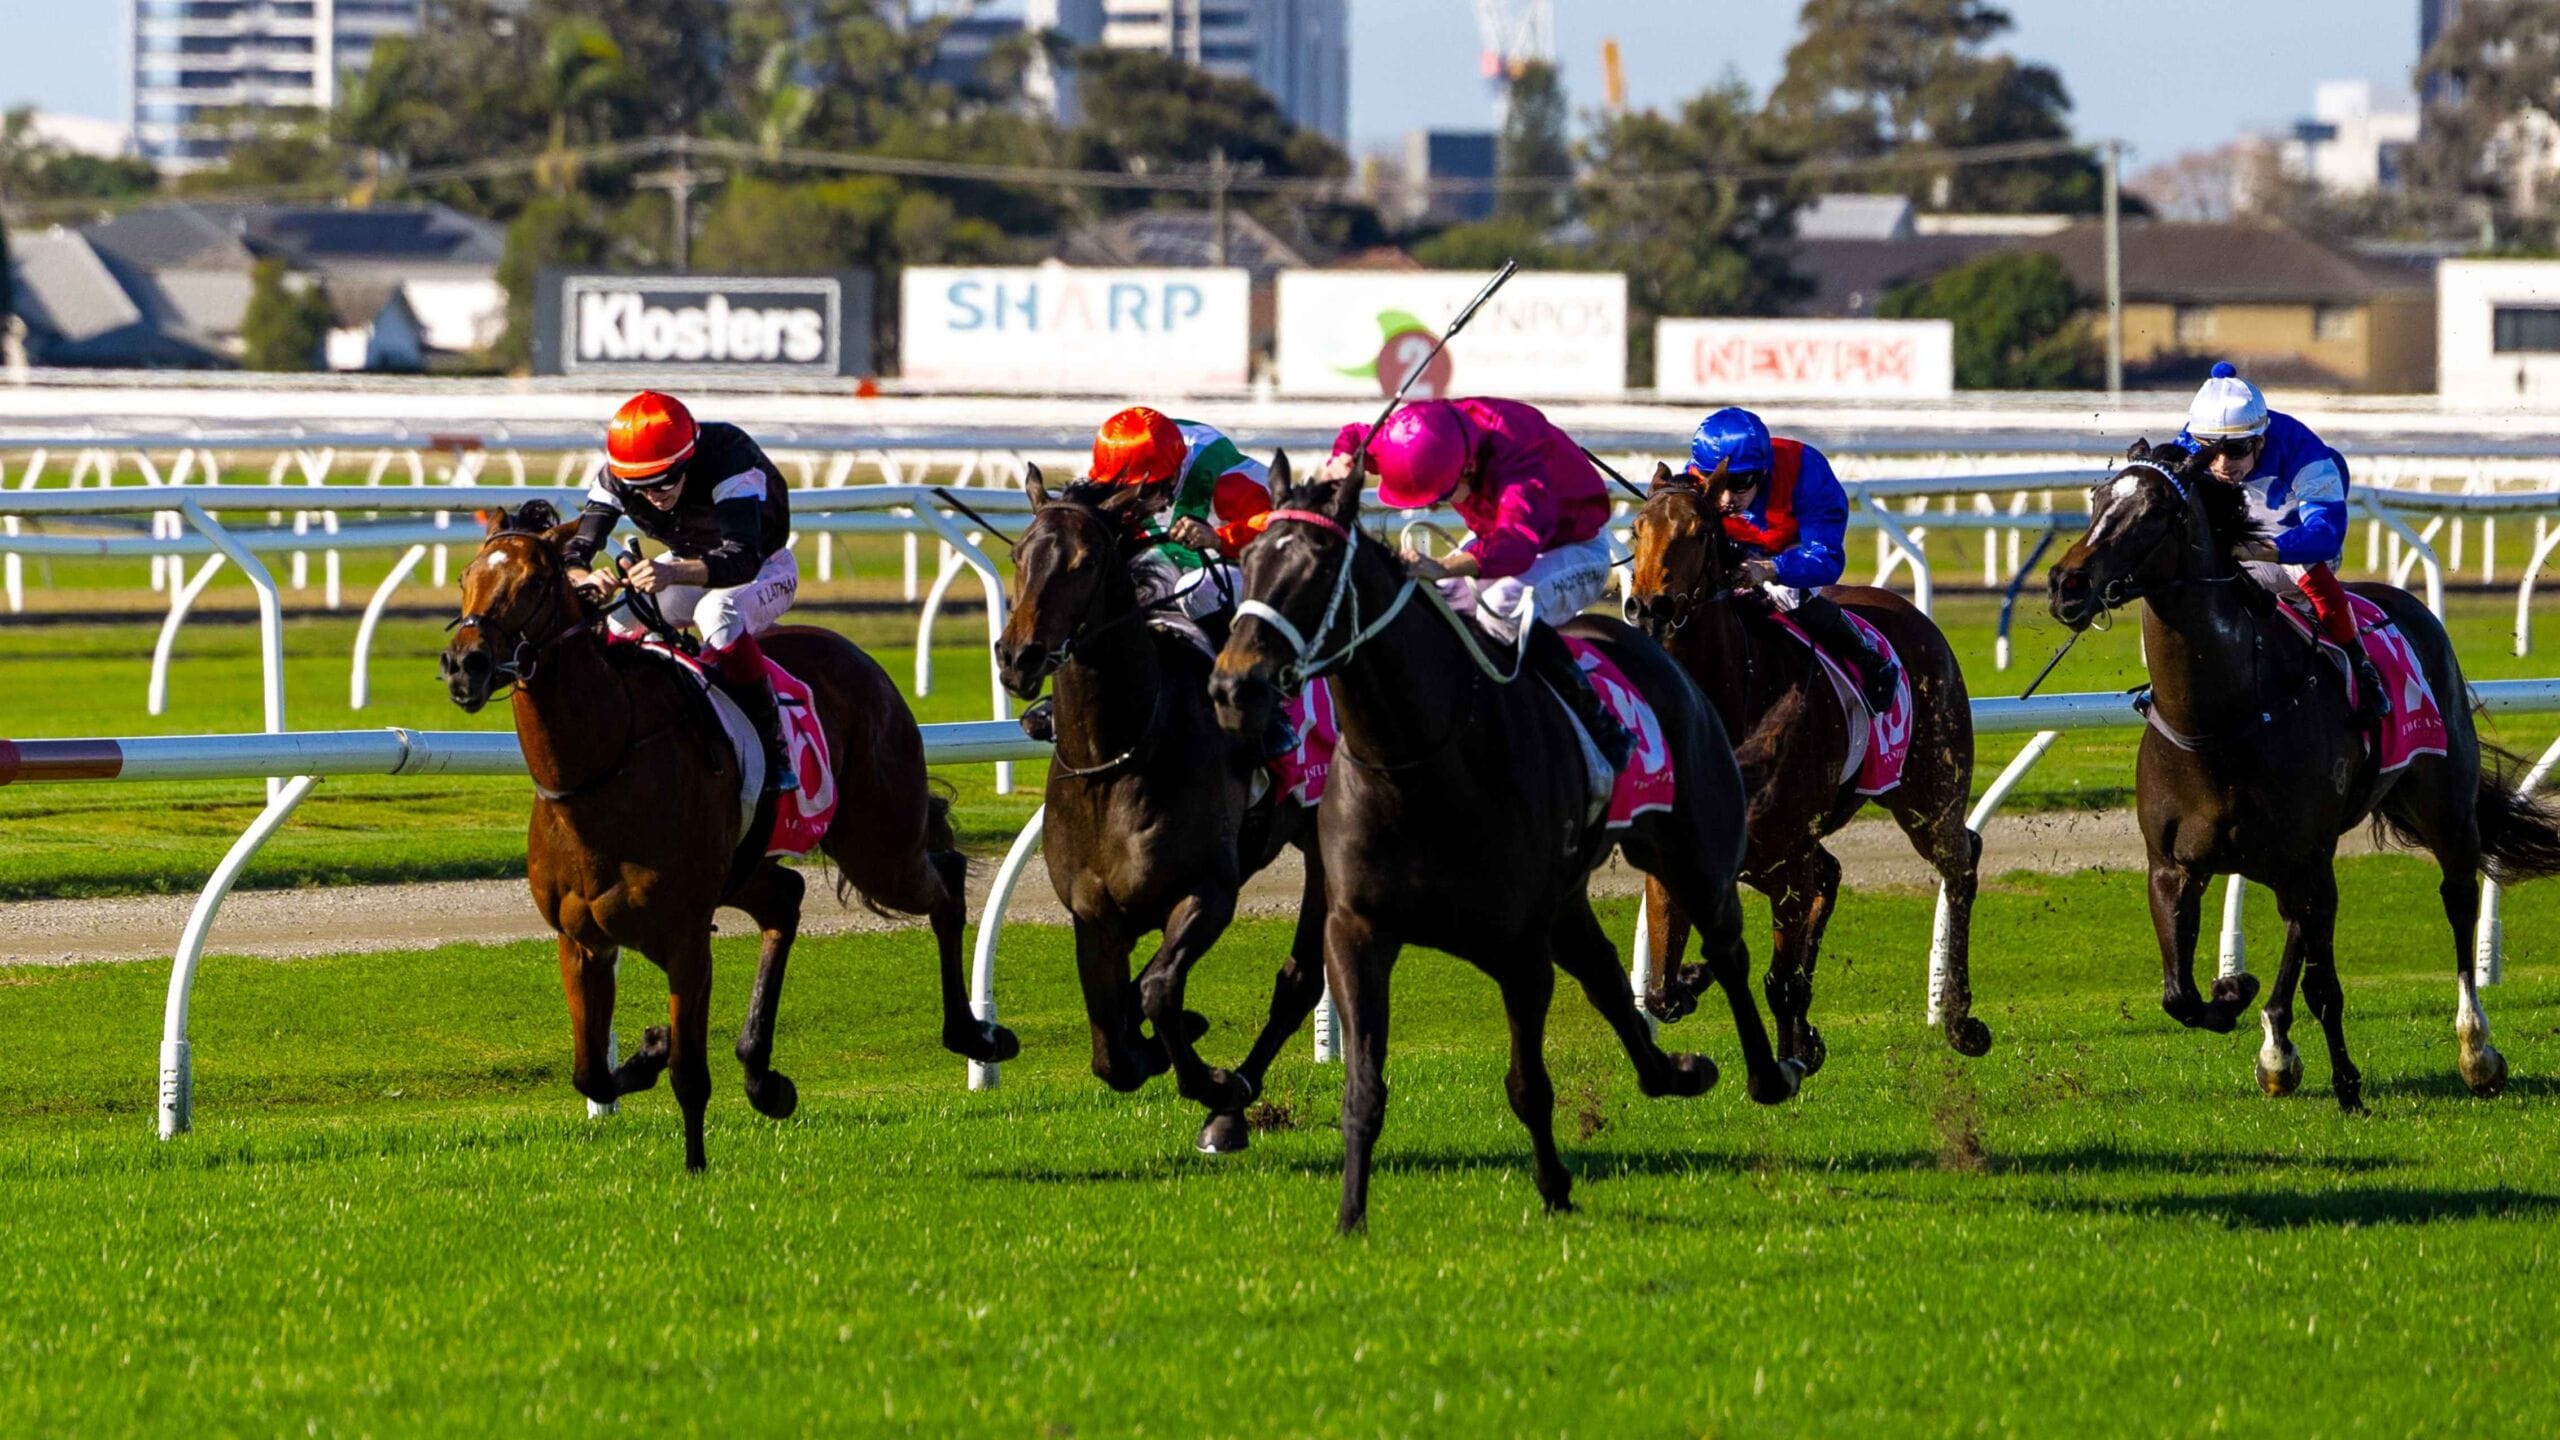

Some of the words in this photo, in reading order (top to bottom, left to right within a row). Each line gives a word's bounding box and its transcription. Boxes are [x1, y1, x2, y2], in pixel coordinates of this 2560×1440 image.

[579, 292, 823, 360] Klosters
[946, 280, 1204, 332] SHARP
[1397, 337, 1434, 400] 2
